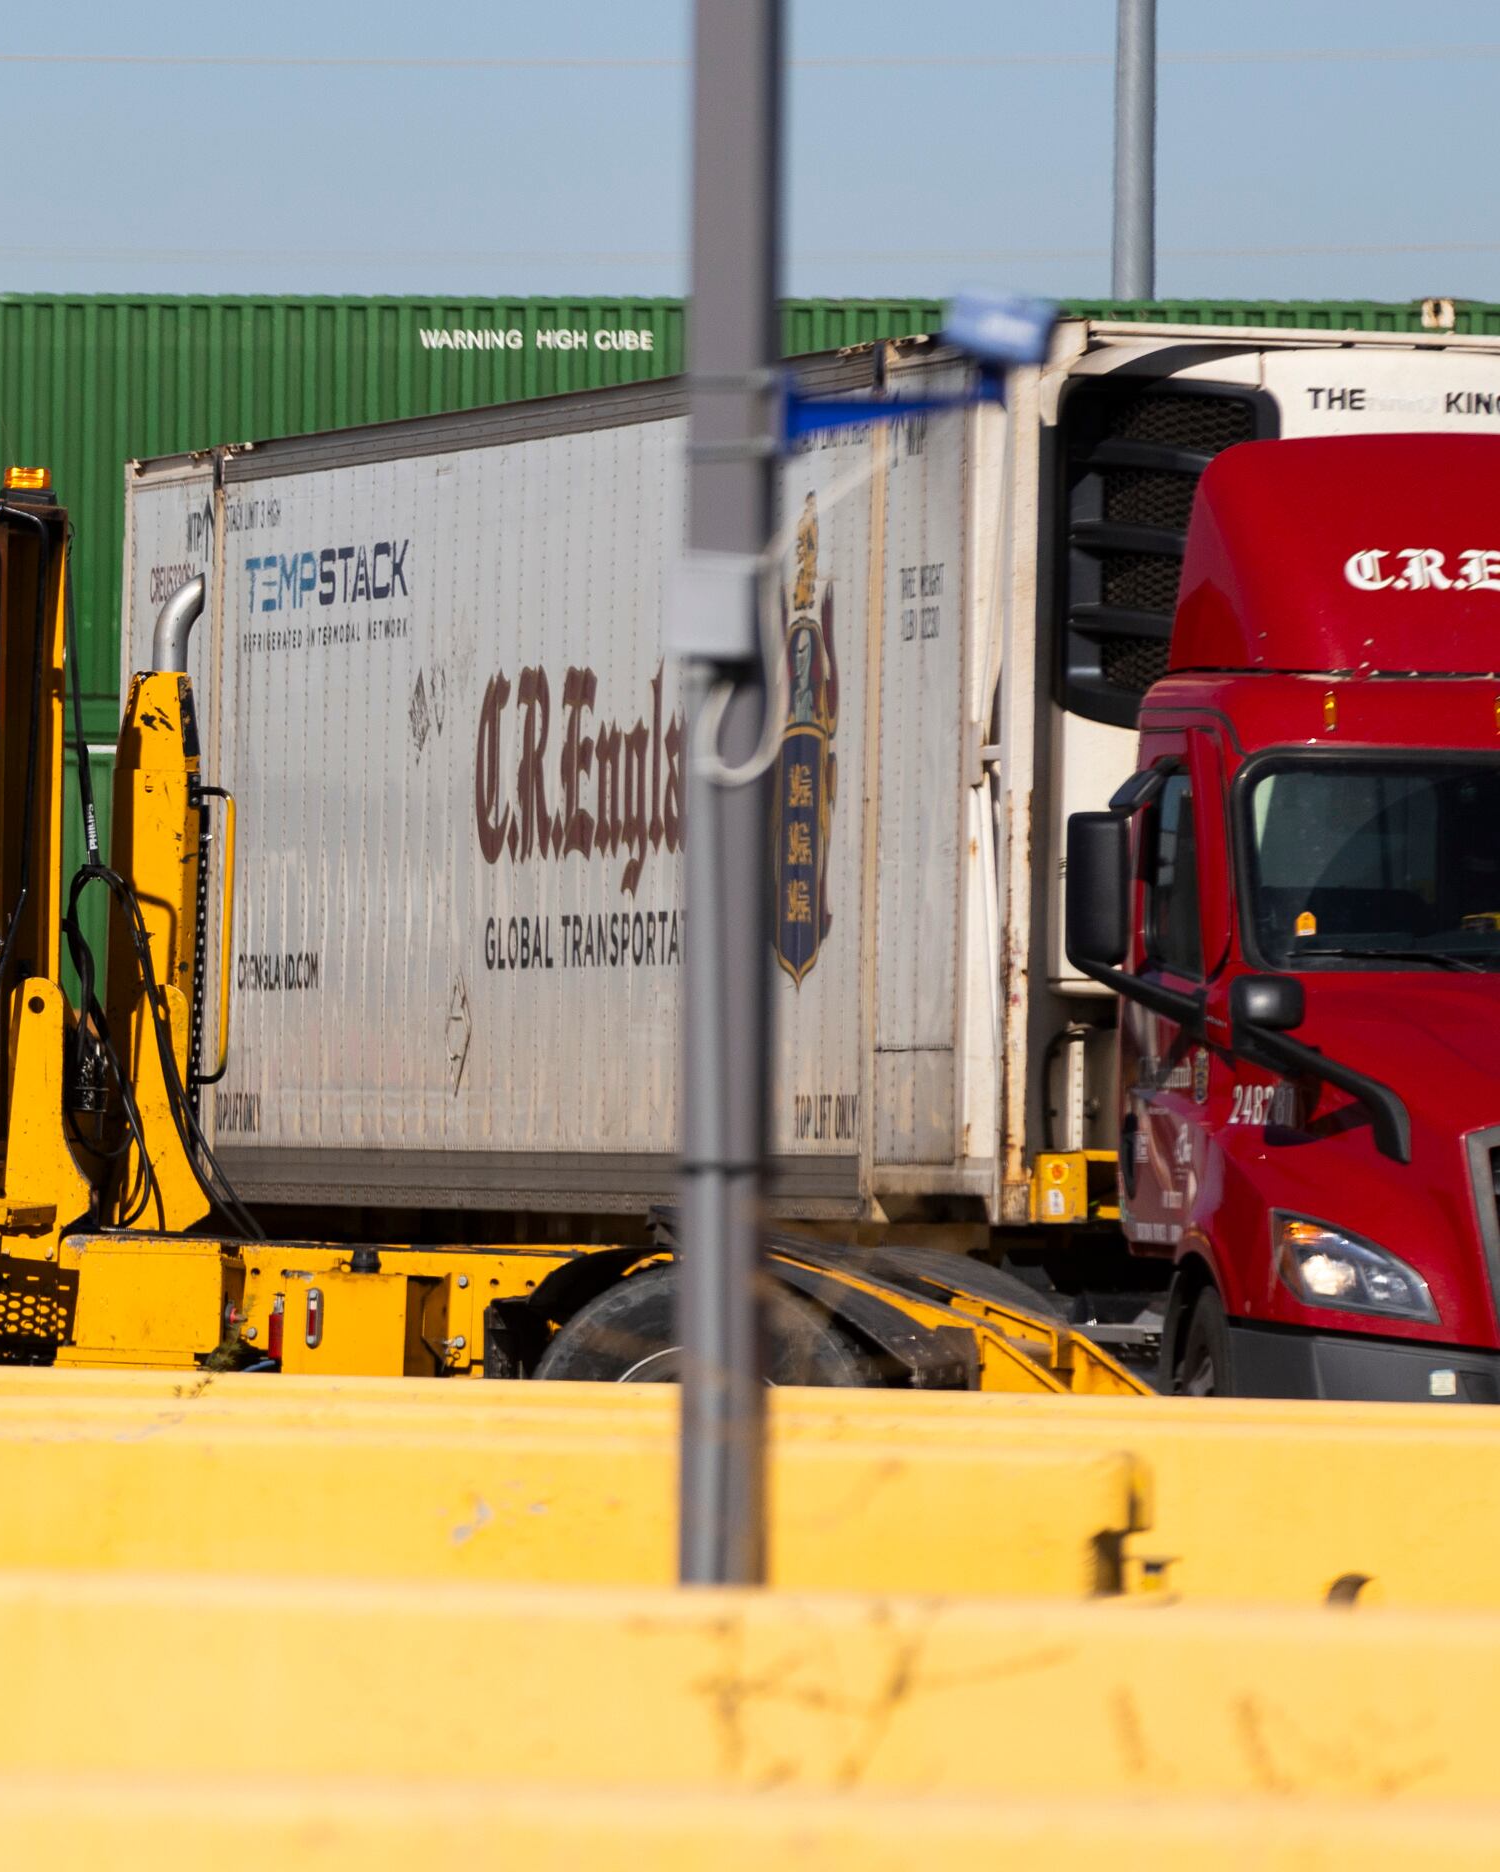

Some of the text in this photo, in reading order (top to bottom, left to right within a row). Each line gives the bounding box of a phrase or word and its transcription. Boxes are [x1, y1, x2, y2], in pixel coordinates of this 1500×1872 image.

[419, 328, 655, 351] WARNING HIGH CUBE
[1307, 387, 1366, 411] THE
[1445, 391, 1500, 415] KIN
[244, 538, 409, 614] TEMPSTACK
[243, 617, 408, 653] REFRIGERATED INTERMODAL NETWORK
[485, 915, 553, 970] GLOBAL
[795, 1093, 858, 1140] TOP LIFT ONLY
